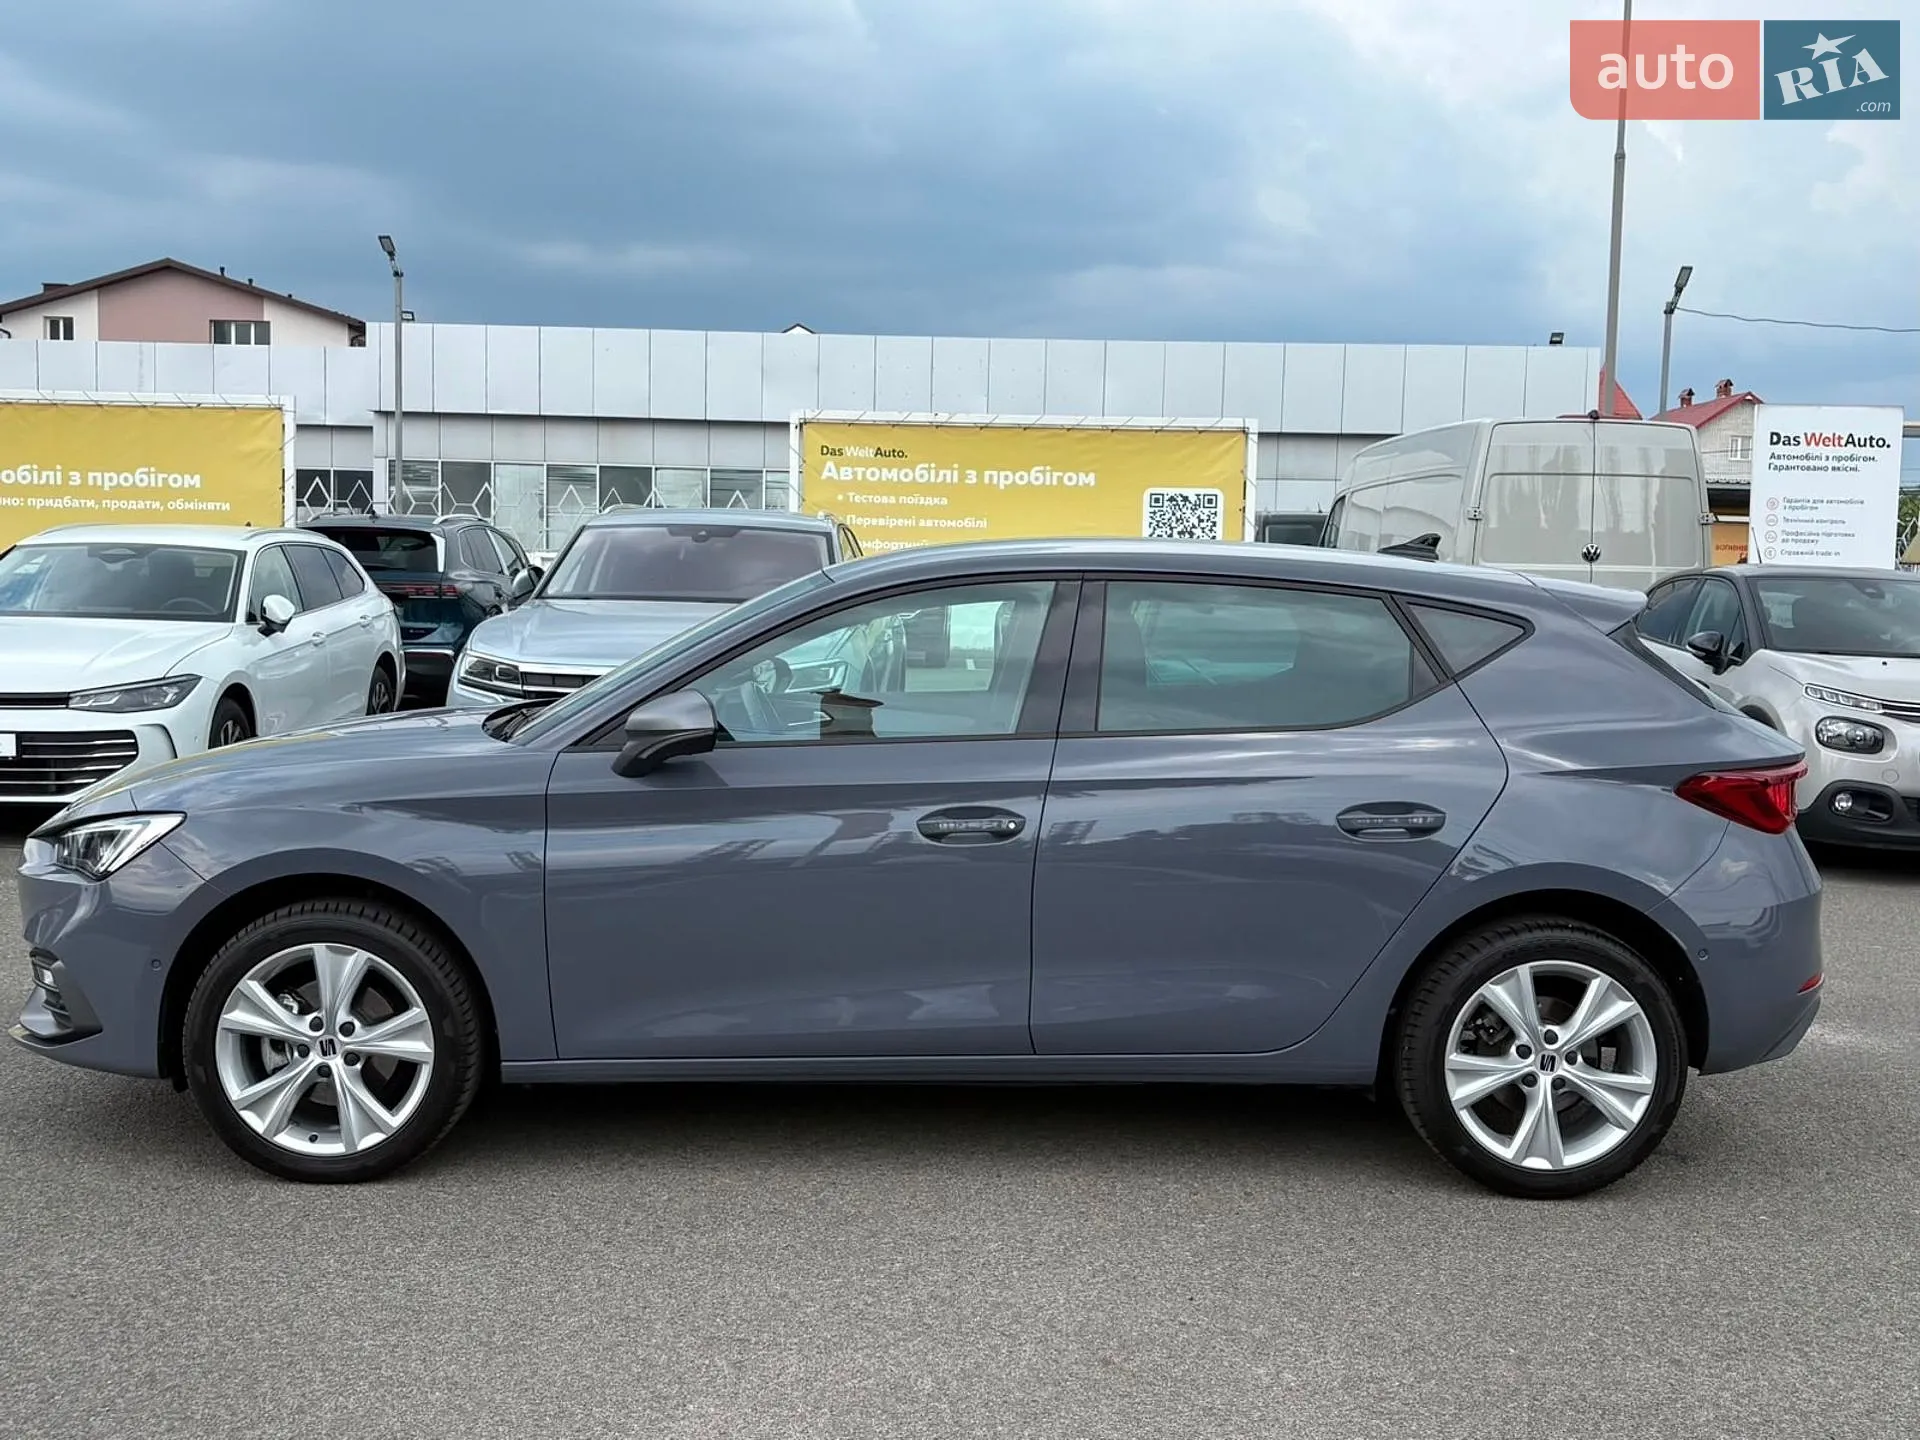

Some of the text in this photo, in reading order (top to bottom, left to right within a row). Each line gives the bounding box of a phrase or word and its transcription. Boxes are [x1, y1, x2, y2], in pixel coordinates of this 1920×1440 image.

[1769, 431, 1891, 449] Das WeltAuto.
[820, 445, 844, 457] Das
[1769, 452, 1823, 462] Автомобілі
[1831, 454, 1878, 464] пробігом.
[821, 461, 1097, 490] Автомобілі з пробігом
[1768, 463, 1829, 473] Гарантовано
[0, 464, 202, 491] обілі з пробігом
[0, 496, 231, 512] но: придбати, продати, обміняти
[847, 492, 949, 506] Тестова поїздка
[846, 514, 988, 529] Перевірені автомобілі
